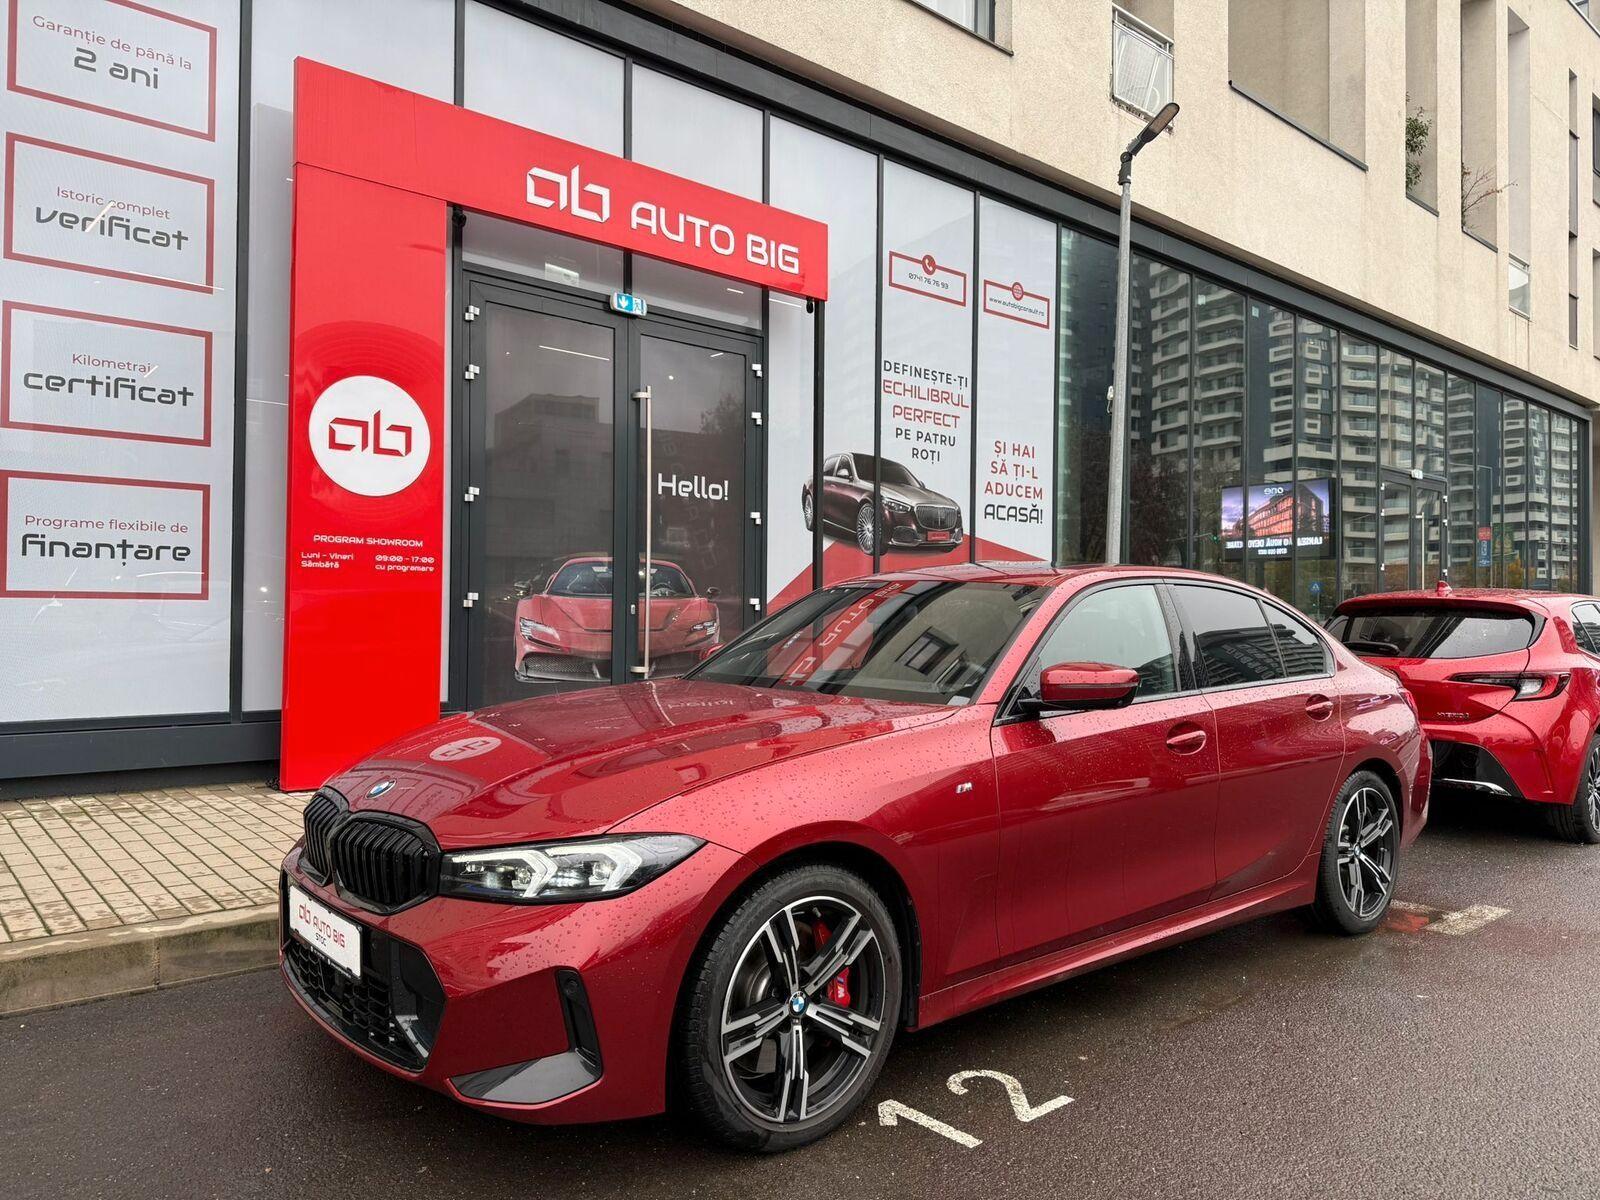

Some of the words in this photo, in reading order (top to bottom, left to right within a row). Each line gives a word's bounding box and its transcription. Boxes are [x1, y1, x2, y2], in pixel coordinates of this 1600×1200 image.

[32, 15, 105, 44] Garanție
[111, 38, 131, 53] de
[136, 47, 174, 66] până
[179, 56, 192, 70] la
[74, 47, 97, 72] 2
[109, 62, 159, 89] ani
[57, 186, 104, 206] Istoric
[109, 200, 170, 220] complet
[35, 206, 189, 250] verificat
[631, 201, 735, 256] AUTO
[746, 233, 800, 275] BIG
[883, 360, 968, 390] DEFINEȘTE-ȚI
[23, 372, 194, 407] certificat
[883, 379, 969, 409] ECHILIBRUL
[892, 405, 960, 429] PERFECT
[895, 427, 911, 441] PE
[916, 430, 956, 447] PATRU
[994, 440, 1007, 458] ȘI
[1012, 443, 1035, 459] HAI
[912, 447, 940, 465] ROȚI
[990, 459, 1008, 476] SĂ
[1013, 463, 1038, 482] ȚI-L
[657, 472, 729, 501] Hello!
[984, 481, 1043, 500] ADUCEM
[25, 515, 104, 534] Programe
[108, 518, 166, 533] flexibile
[170, 522, 189, 534] de
[984, 503, 1043, 524] ACASĂ!
[21, 533, 191, 567] finanțare
[313, 534, 365, 545] PROGRAM
[366, 537, 424, 548] SHOWROOM
[301, 552, 320, 560] Luni
[329, 553, 355, 561] Vineri
[375, 554, 404, 563] 09:00
[411, 555, 435, 564] 17:00
[387, 564, 435, 573] programare
[313, 916, 332, 938] AUTO
[333, 929, 346, 948] BIG
[878, 1069, 1075, 1148] 12
